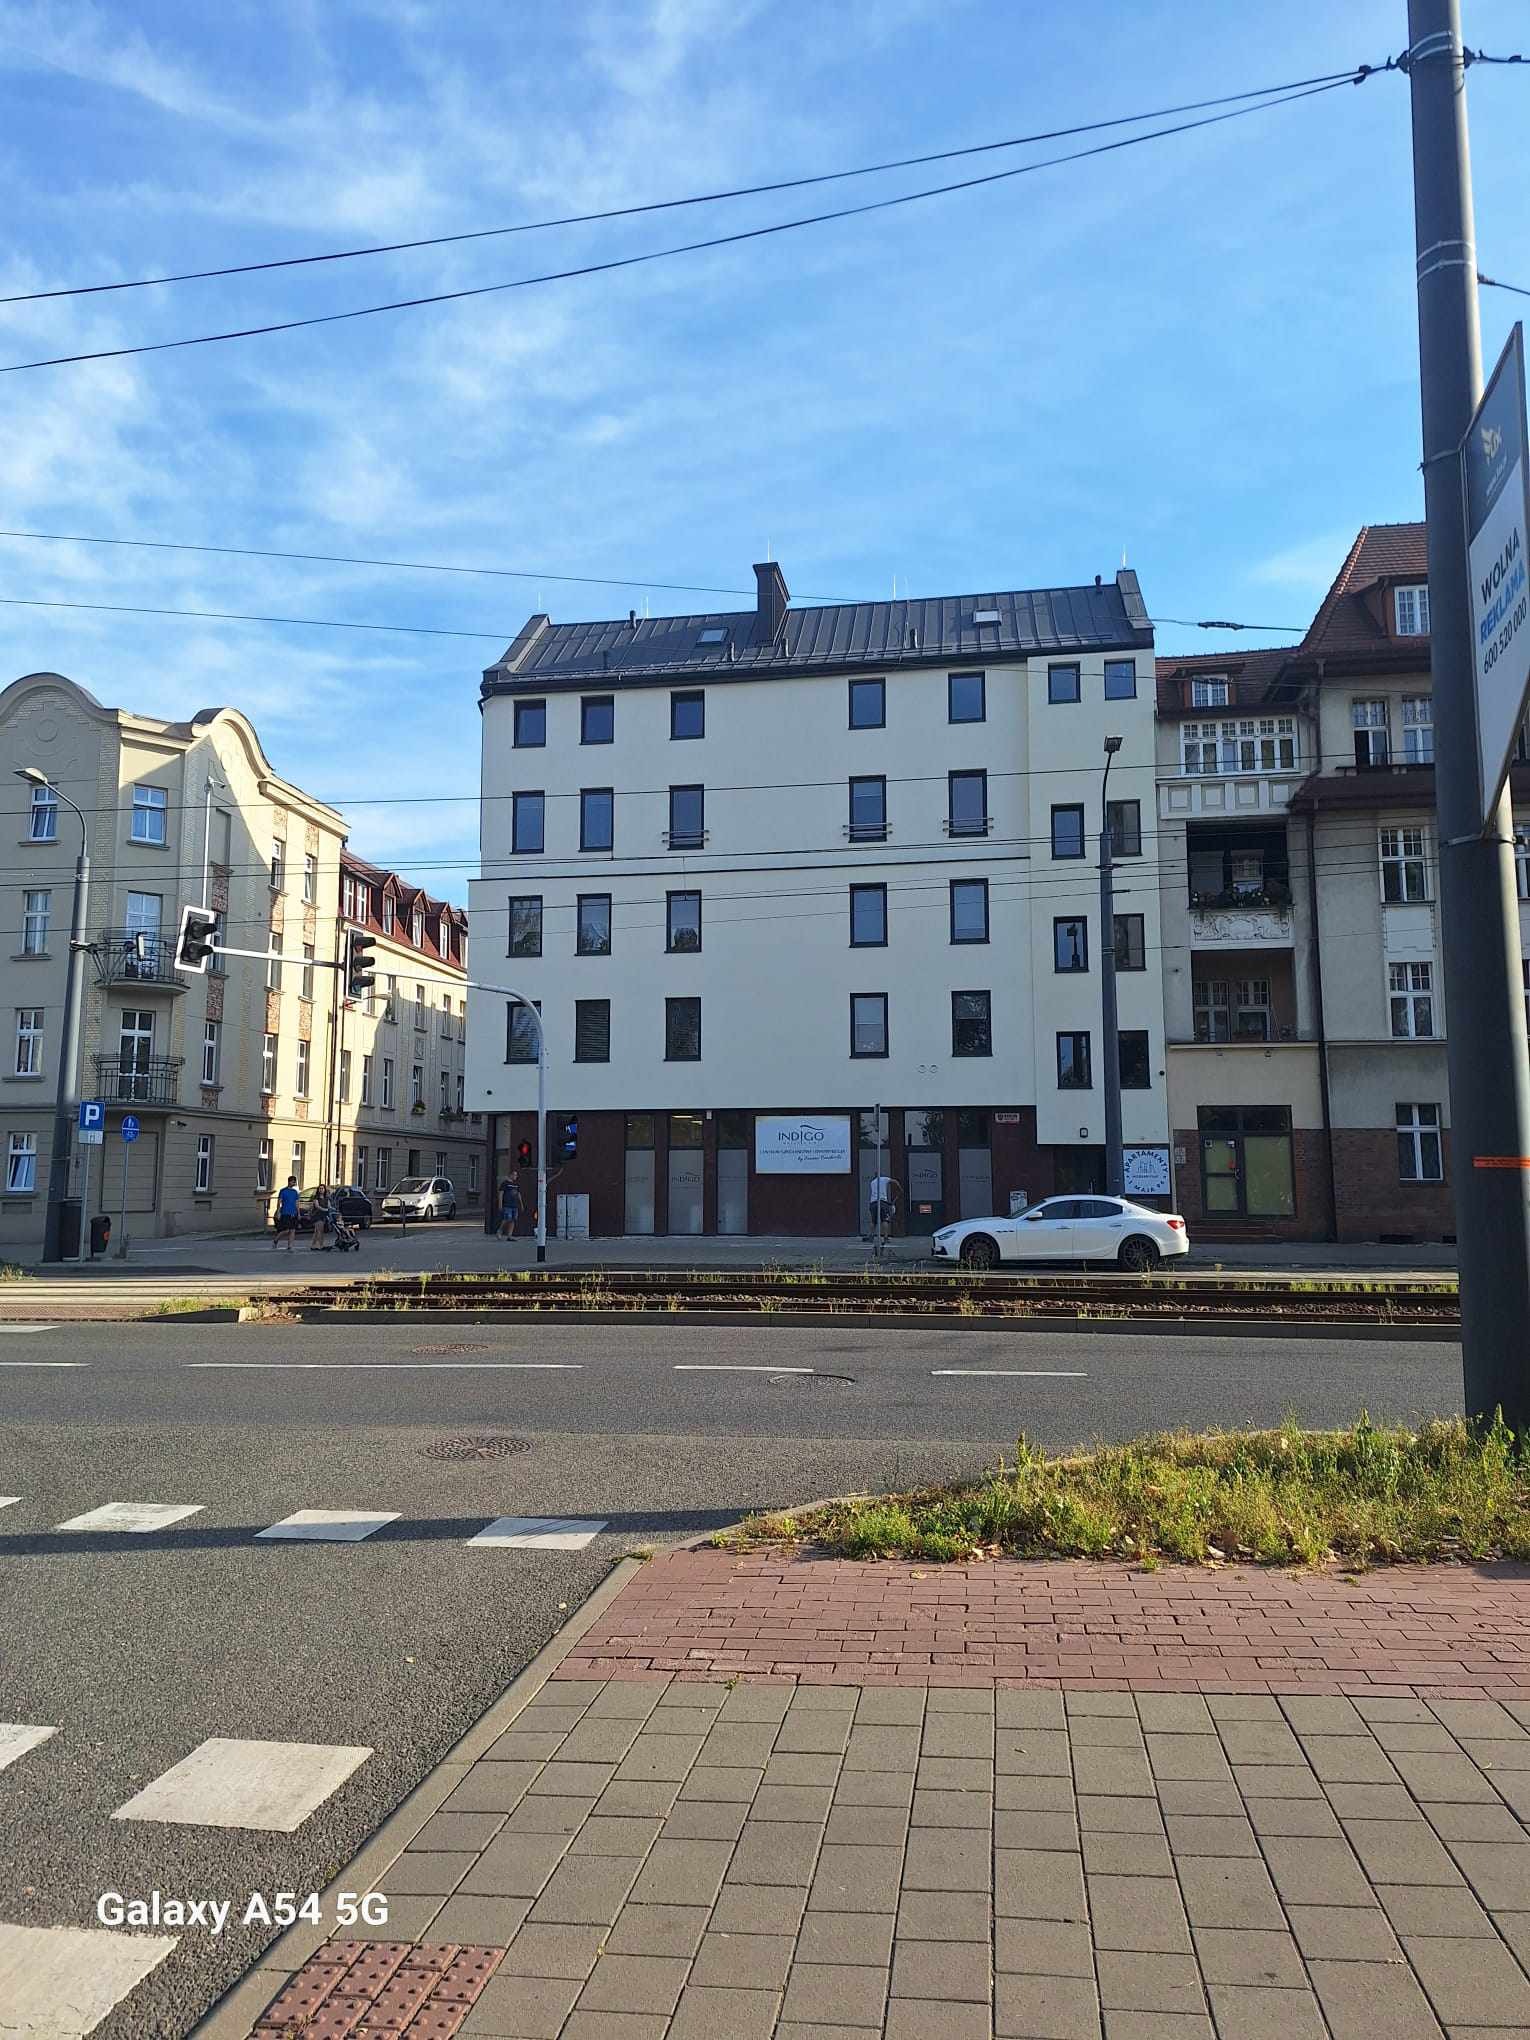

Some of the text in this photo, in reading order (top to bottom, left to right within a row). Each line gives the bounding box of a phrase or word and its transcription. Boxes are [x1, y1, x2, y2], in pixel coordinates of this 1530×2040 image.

[1481, 527, 1520, 604] WOLNA
[1480, 559, 1525, 645] REKLAMA
[1483, 597, 1527, 674] 600 520 000
[85, 1104, 100, 1126] P
[778, 1130, 824, 1144] INDIGO
[1124, 1150, 1169, 1173] APARTAMENTY
